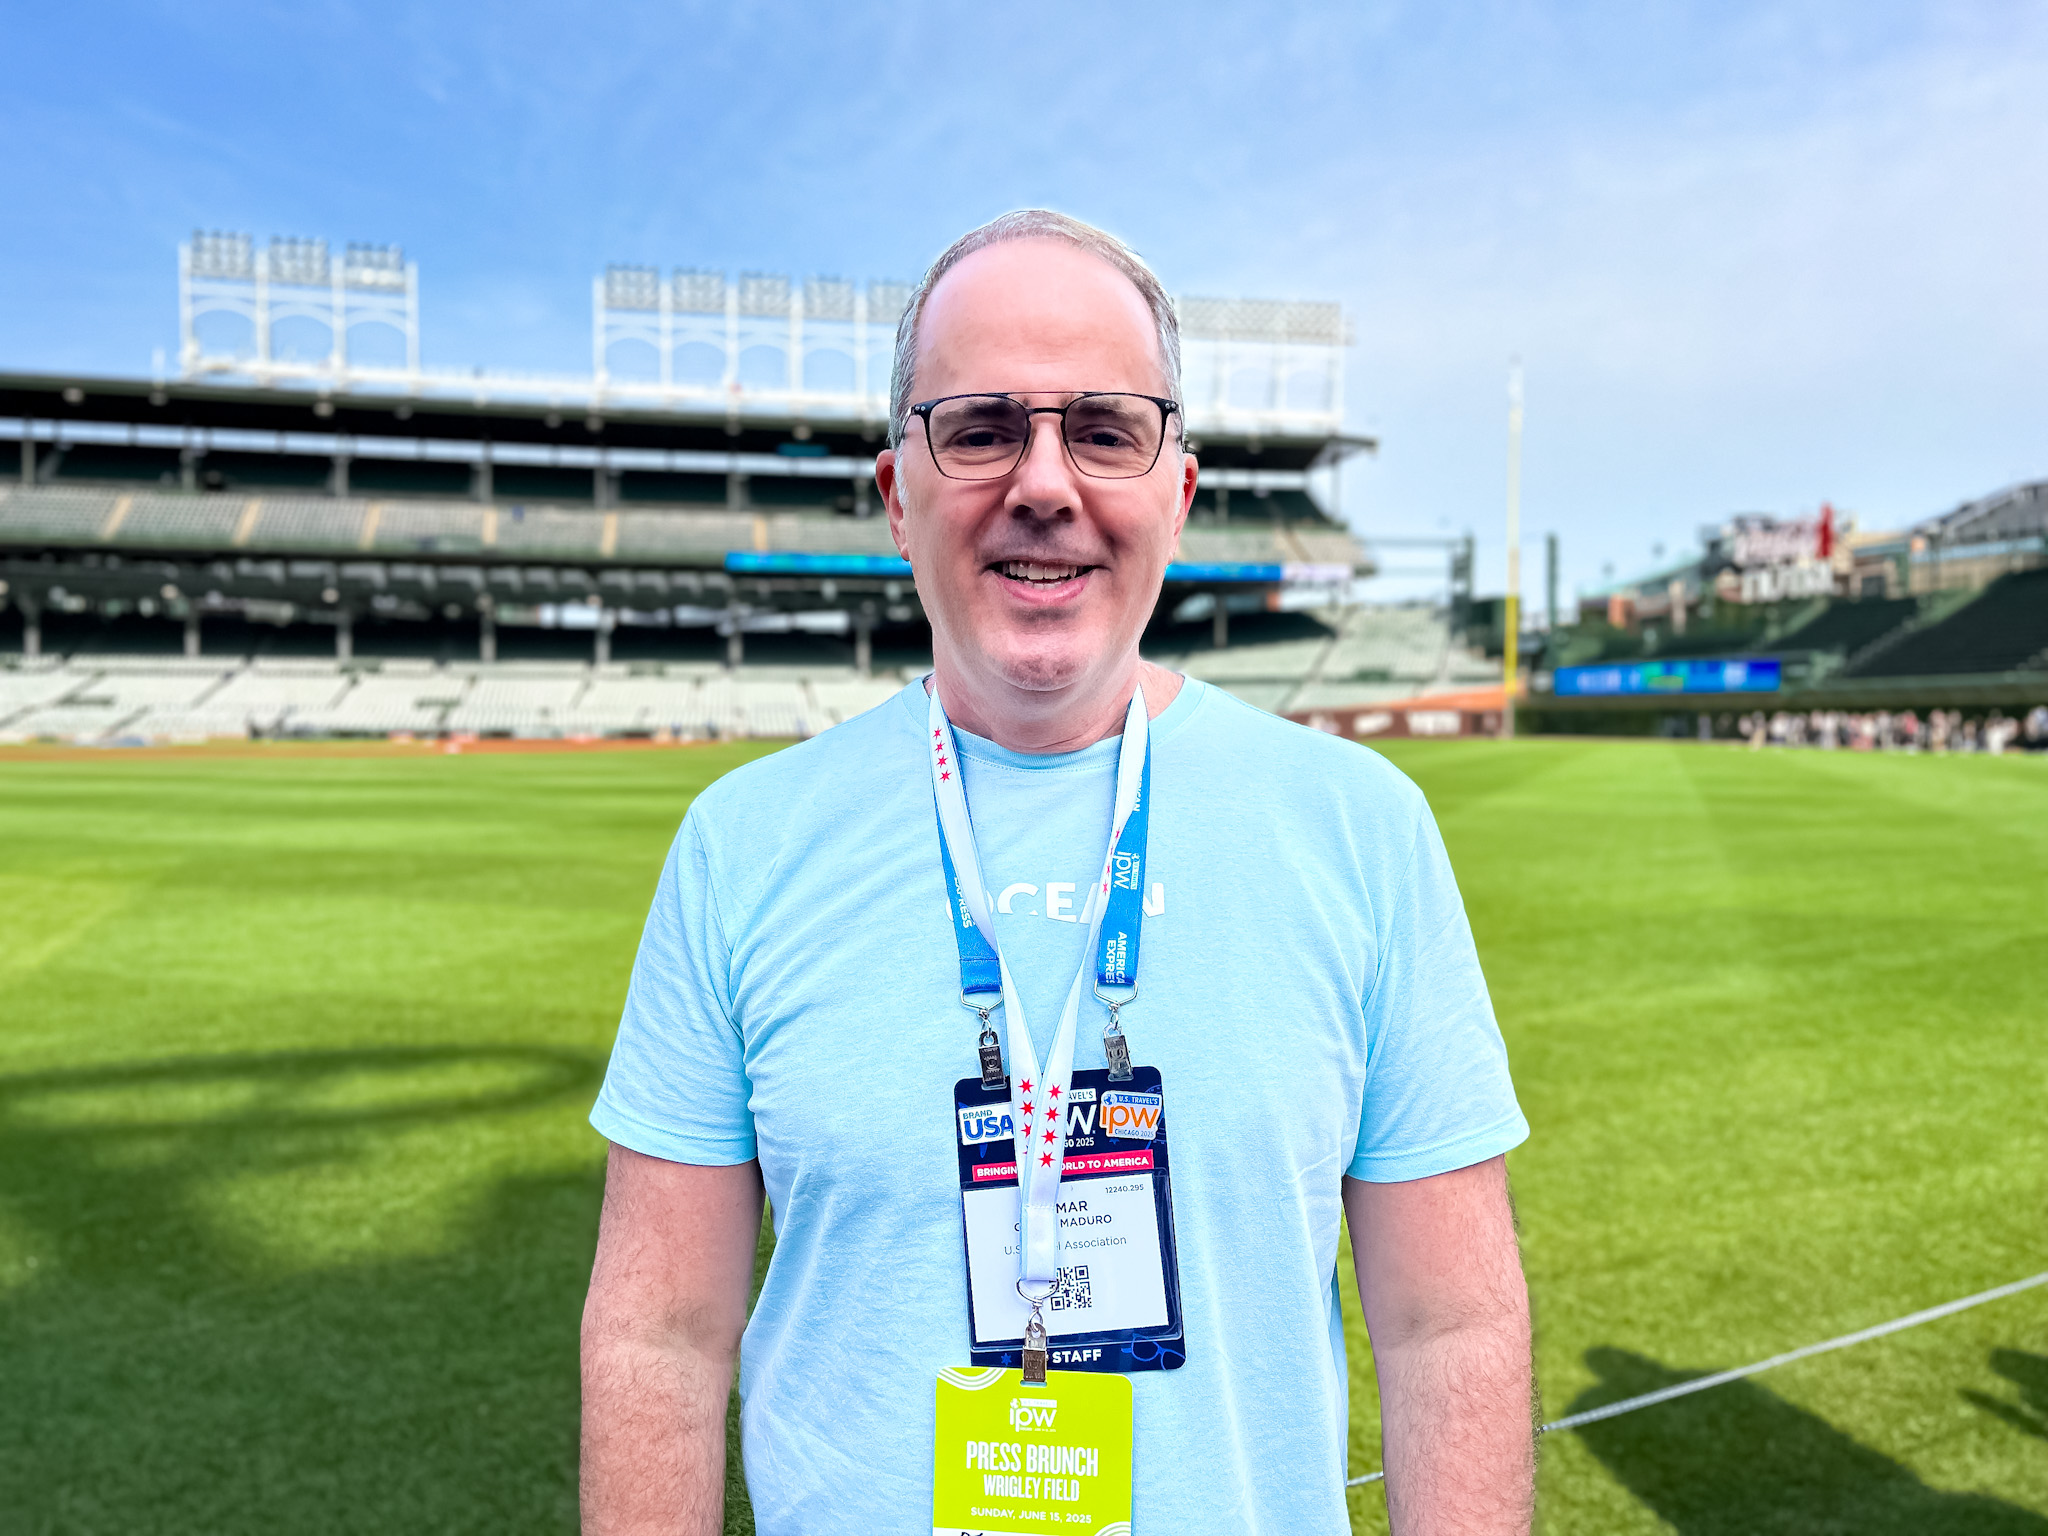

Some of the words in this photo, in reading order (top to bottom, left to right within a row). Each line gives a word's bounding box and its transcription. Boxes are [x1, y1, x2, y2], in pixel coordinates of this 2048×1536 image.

[946, 882, 1165, 924] CEN
[954, 877, 974, 928] RESS
[1105, 939, 1117, 983] EXPRE
[1116, 931, 1128, 983] AMERICA
[1131, 1096, 1158, 1105] TRAVEL'S
[962, 1109, 993, 1120] BRAND
[964, 1114, 1014, 1140] USA
[1114, 1128, 1140, 1137] CHICAGO
[1075, 1137, 1095, 1148] 2025
[976, 1165, 1017, 1177] BRINGIN
[1062, 1161, 1085, 1171] ORLD
[1087, 1160, 1101, 1169] TO
[1103, 1156, 1149, 1168] AMERICA
[1105, 1183, 1144, 1194] 12240.295
[1055, 1200, 1088, 1214] MAR
[1060, 1214, 1112, 1228] MADURO
[1004, 1244, 1020, 1255] U.S
[1064, 1236, 1127, 1251] Association
[1052, 1349, 1102, 1364] STAFF
[966, 1440, 1021, 1472] PRESS
[1026, 1444, 1098, 1477] BRUNCH
[983, 1474, 1041, 1499] WRIGLEY
[1043, 1478, 1080, 1501] FIELD
[970, 1506, 1016, 1520] SUNDAY,
[1018, 1510, 1046, 1521] JUNE
[1050, 1512, 1062, 1523] 15,
[1066, 1513, 1092, 1524] 2025
